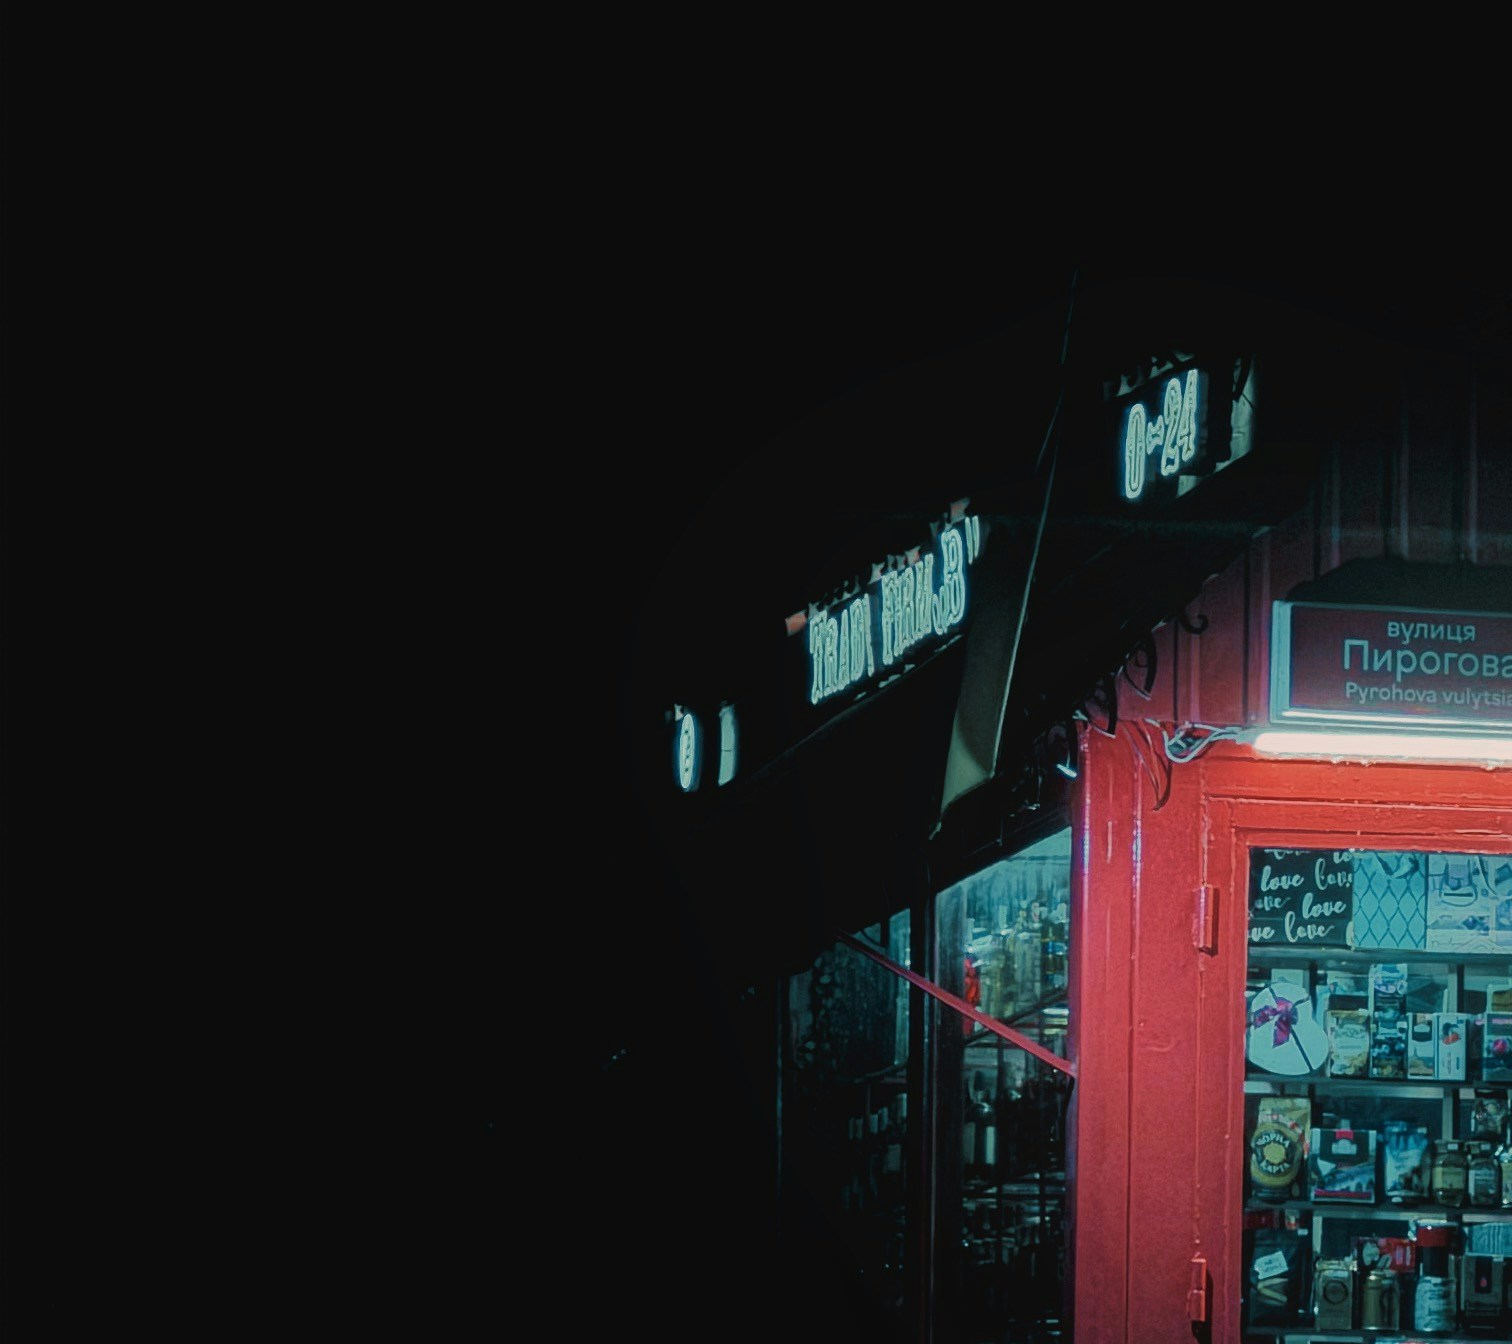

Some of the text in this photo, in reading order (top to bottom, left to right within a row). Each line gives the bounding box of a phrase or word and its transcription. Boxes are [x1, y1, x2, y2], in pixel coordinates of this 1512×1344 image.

[1125, 368, 1198, 499] 0-24
[1387, 621, 1476, 644] вулиця
[1345, 682, 1437, 705] Pyrohova
[1260, 864, 1305, 892] love
[1302, 892, 1347, 919] love
[1284, 910, 1335, 943] love
